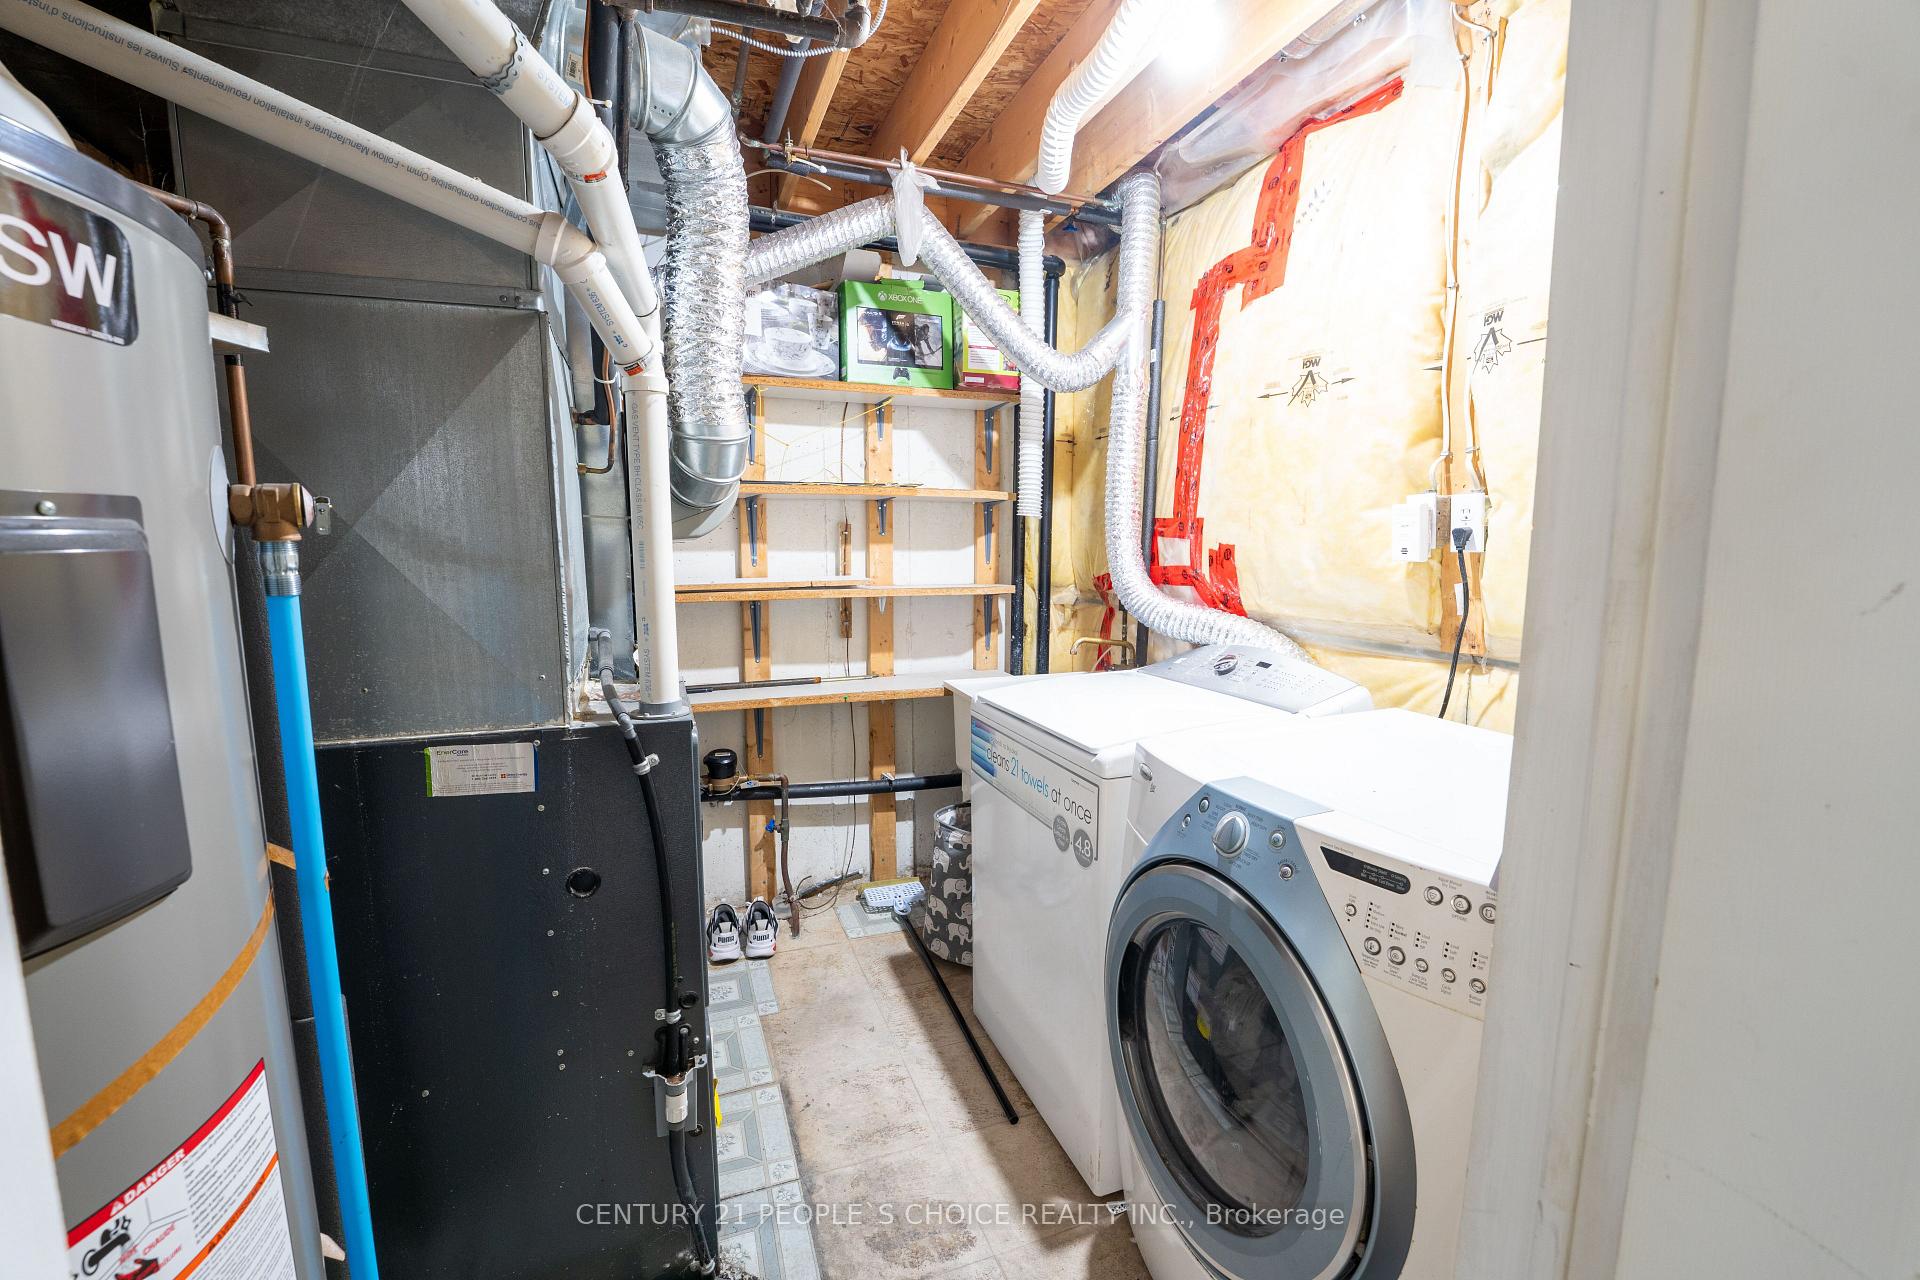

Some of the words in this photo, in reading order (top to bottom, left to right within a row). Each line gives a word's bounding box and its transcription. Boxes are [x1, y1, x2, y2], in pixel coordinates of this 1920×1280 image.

[59, 10, 126, 46] instructions
[124, 39, 143, 55] les
[143, 48, 180, 71] Suivez
[250, 95, 304, 126] installation
[303, 117, 370, 156] Manufacturer's
[369, 148, 400, 168] Follow
[429, 174, 479, 204] combustible
[478, 196, 528, 225] construction
[888, 294, 907, 303] XBOX
[907, 296, 925, 304] ONE
[594, 301, 613, 327] SYSTEM
[986, 747, 1011, 772] cleans
[1010, 756, 1019, 779] 21
[1021, 766, 1049, 799] towels
[1051, 787, 1062, 807] at
[1063, 795, 1092, 825] once
[1075, 836, 1091, 857] 4.8
[717, 934, 735, 944] PUMA
[752, 933, 770, 941] PUMA
[123, 1148, 186, 1204] DANGER
